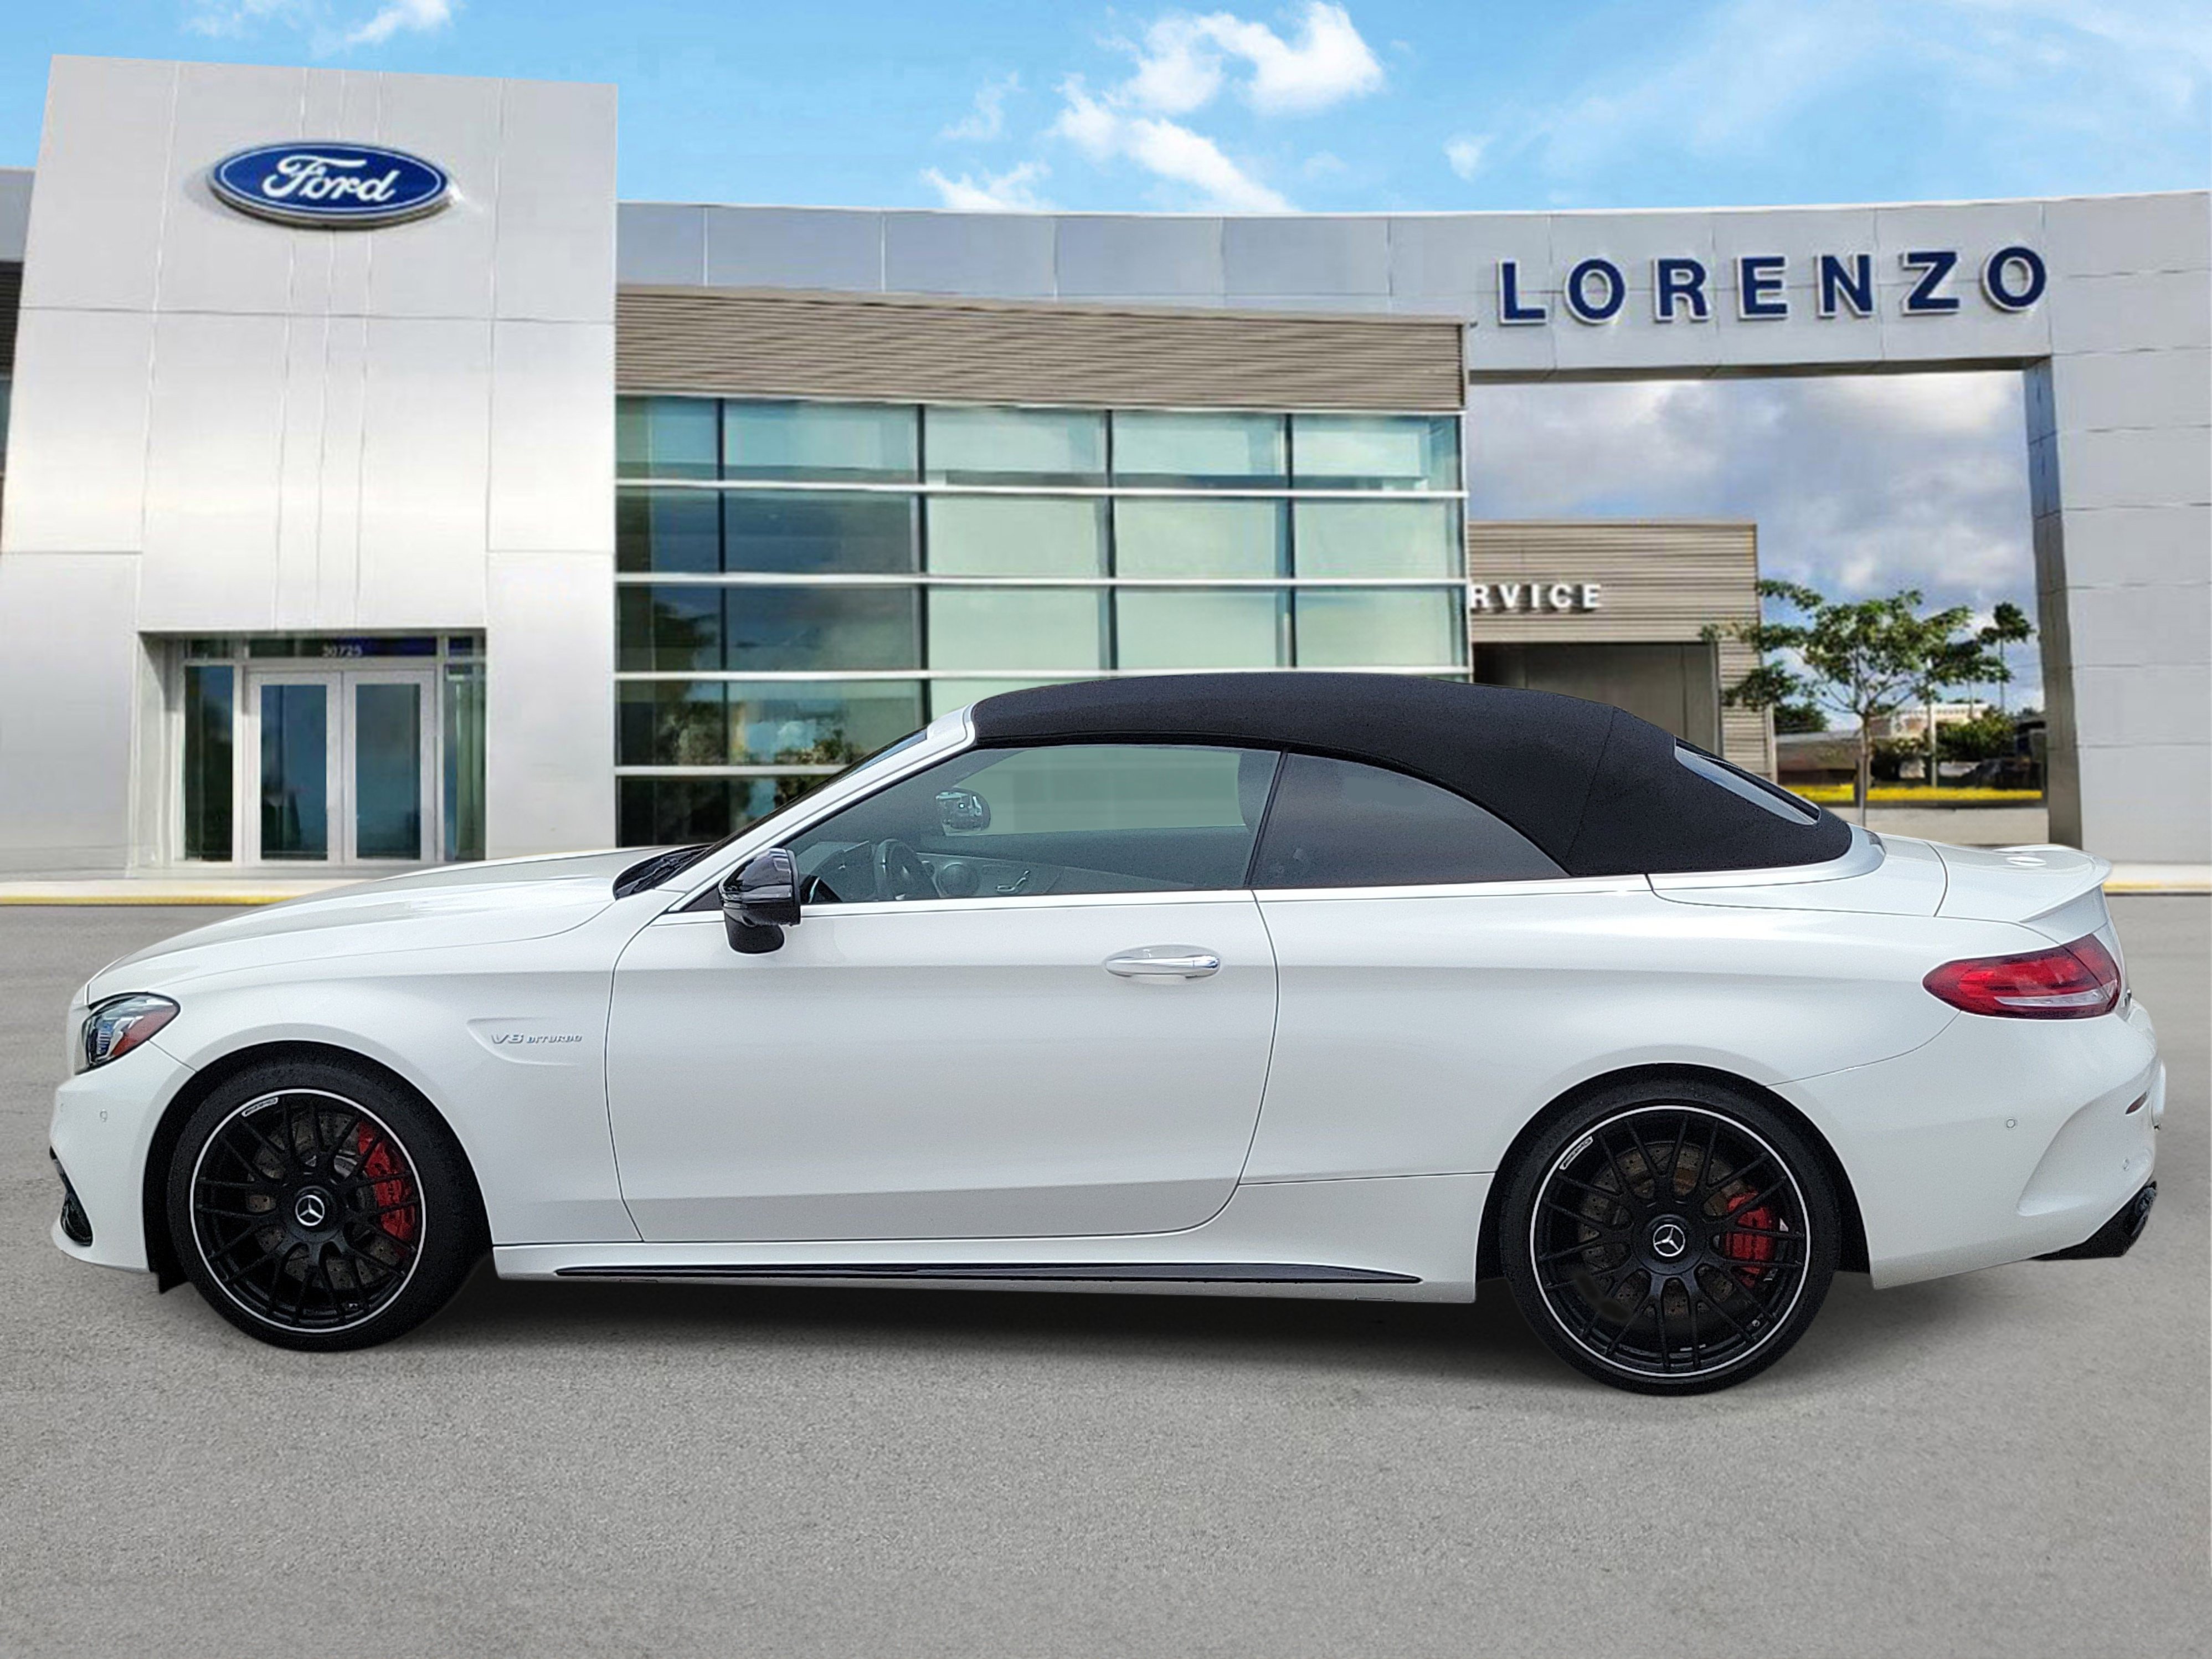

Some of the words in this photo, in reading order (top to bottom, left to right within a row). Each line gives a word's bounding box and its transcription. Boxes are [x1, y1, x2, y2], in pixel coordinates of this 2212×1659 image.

[263, 155, 400, 202] Ford
[1499, 246, 2048, 325] LORENZO
[491, 1033, 524, 1044] V8
[526, 1034, 583, 1044] BITURBO
